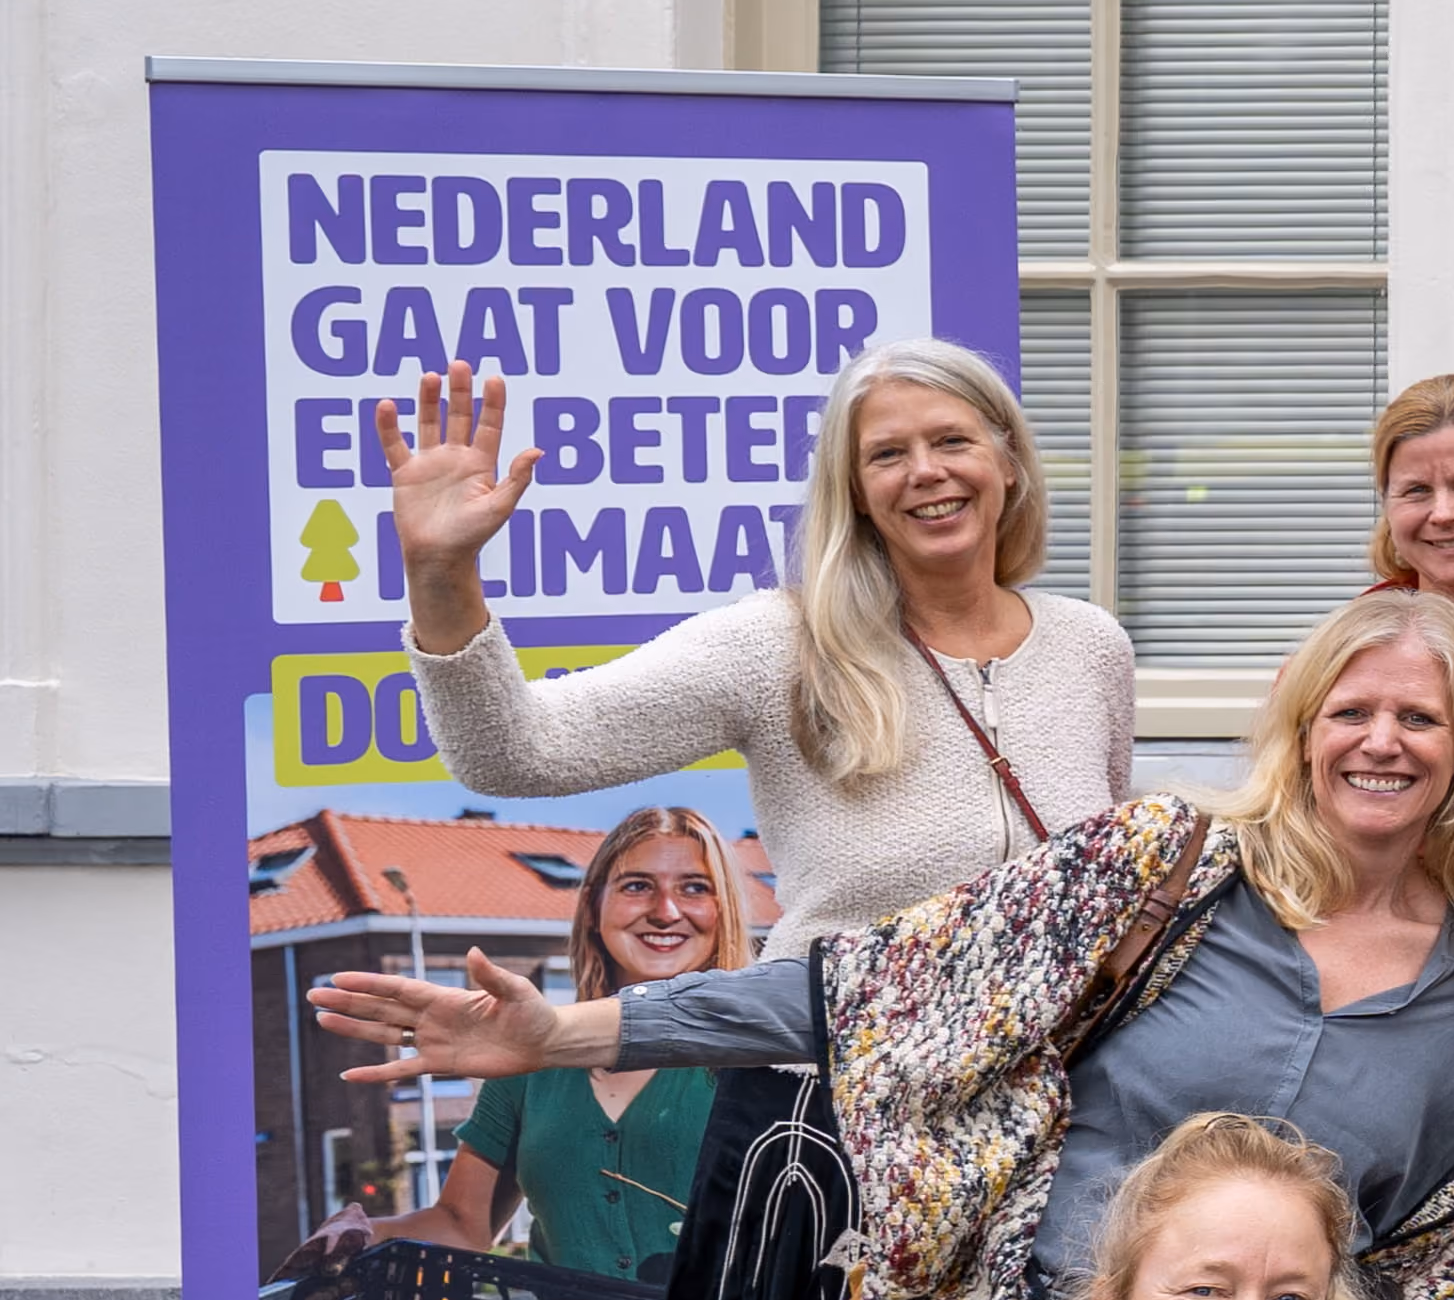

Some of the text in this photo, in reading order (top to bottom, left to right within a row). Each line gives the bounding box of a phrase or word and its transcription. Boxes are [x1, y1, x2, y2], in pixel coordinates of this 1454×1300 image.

[287, 174, 906, 268] NEDERLAND
[290, 287, 879, 377] GAAT VOOR
